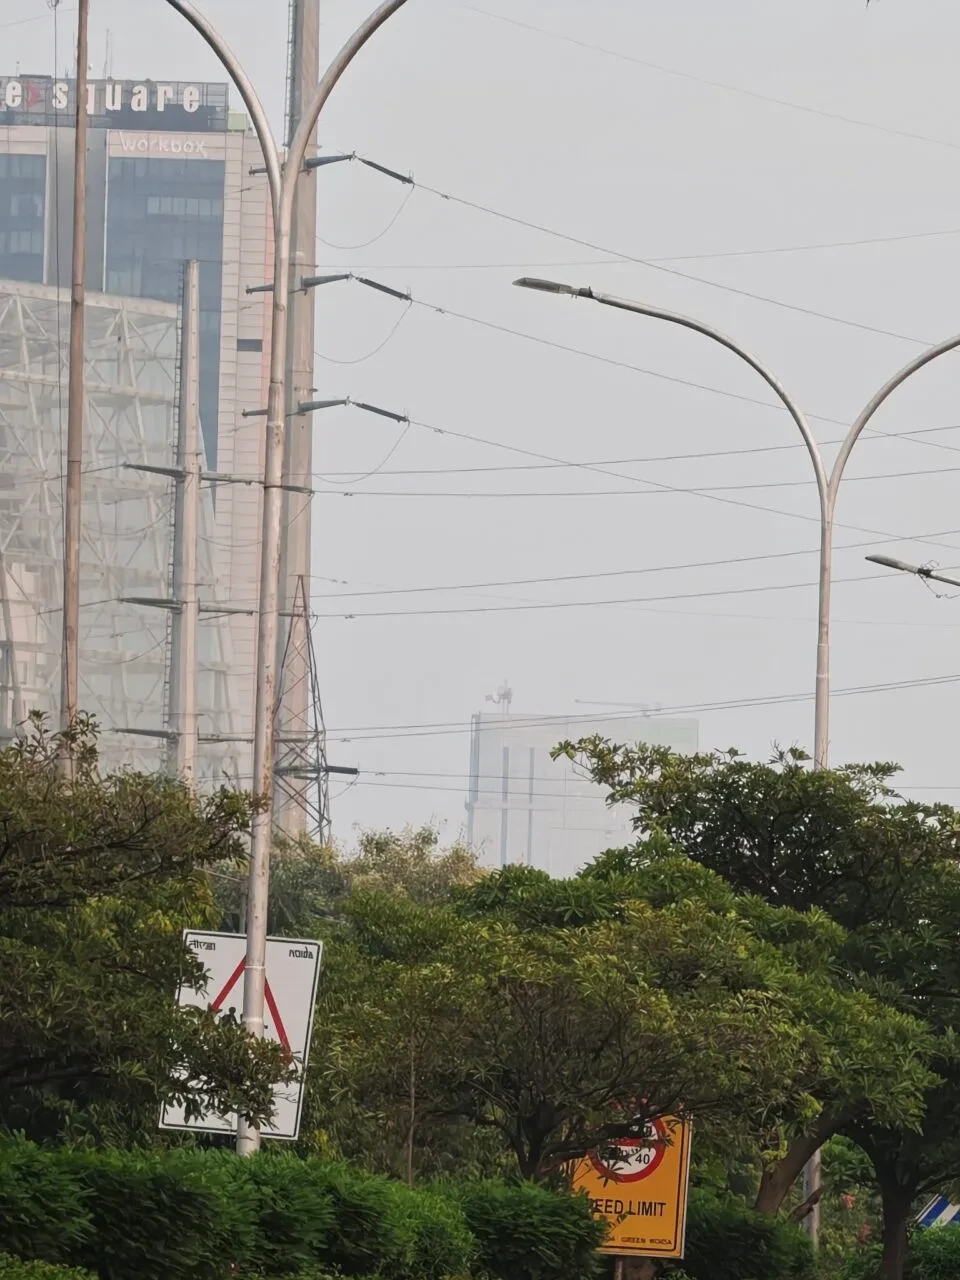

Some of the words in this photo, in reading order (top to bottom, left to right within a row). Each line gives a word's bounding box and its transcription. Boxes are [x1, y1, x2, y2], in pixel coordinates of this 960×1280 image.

[635, 1153, 650, 1165] 40
[591, 1198, 624, 1215] EED
[627, 1200, 666, 1217] LIMIT
